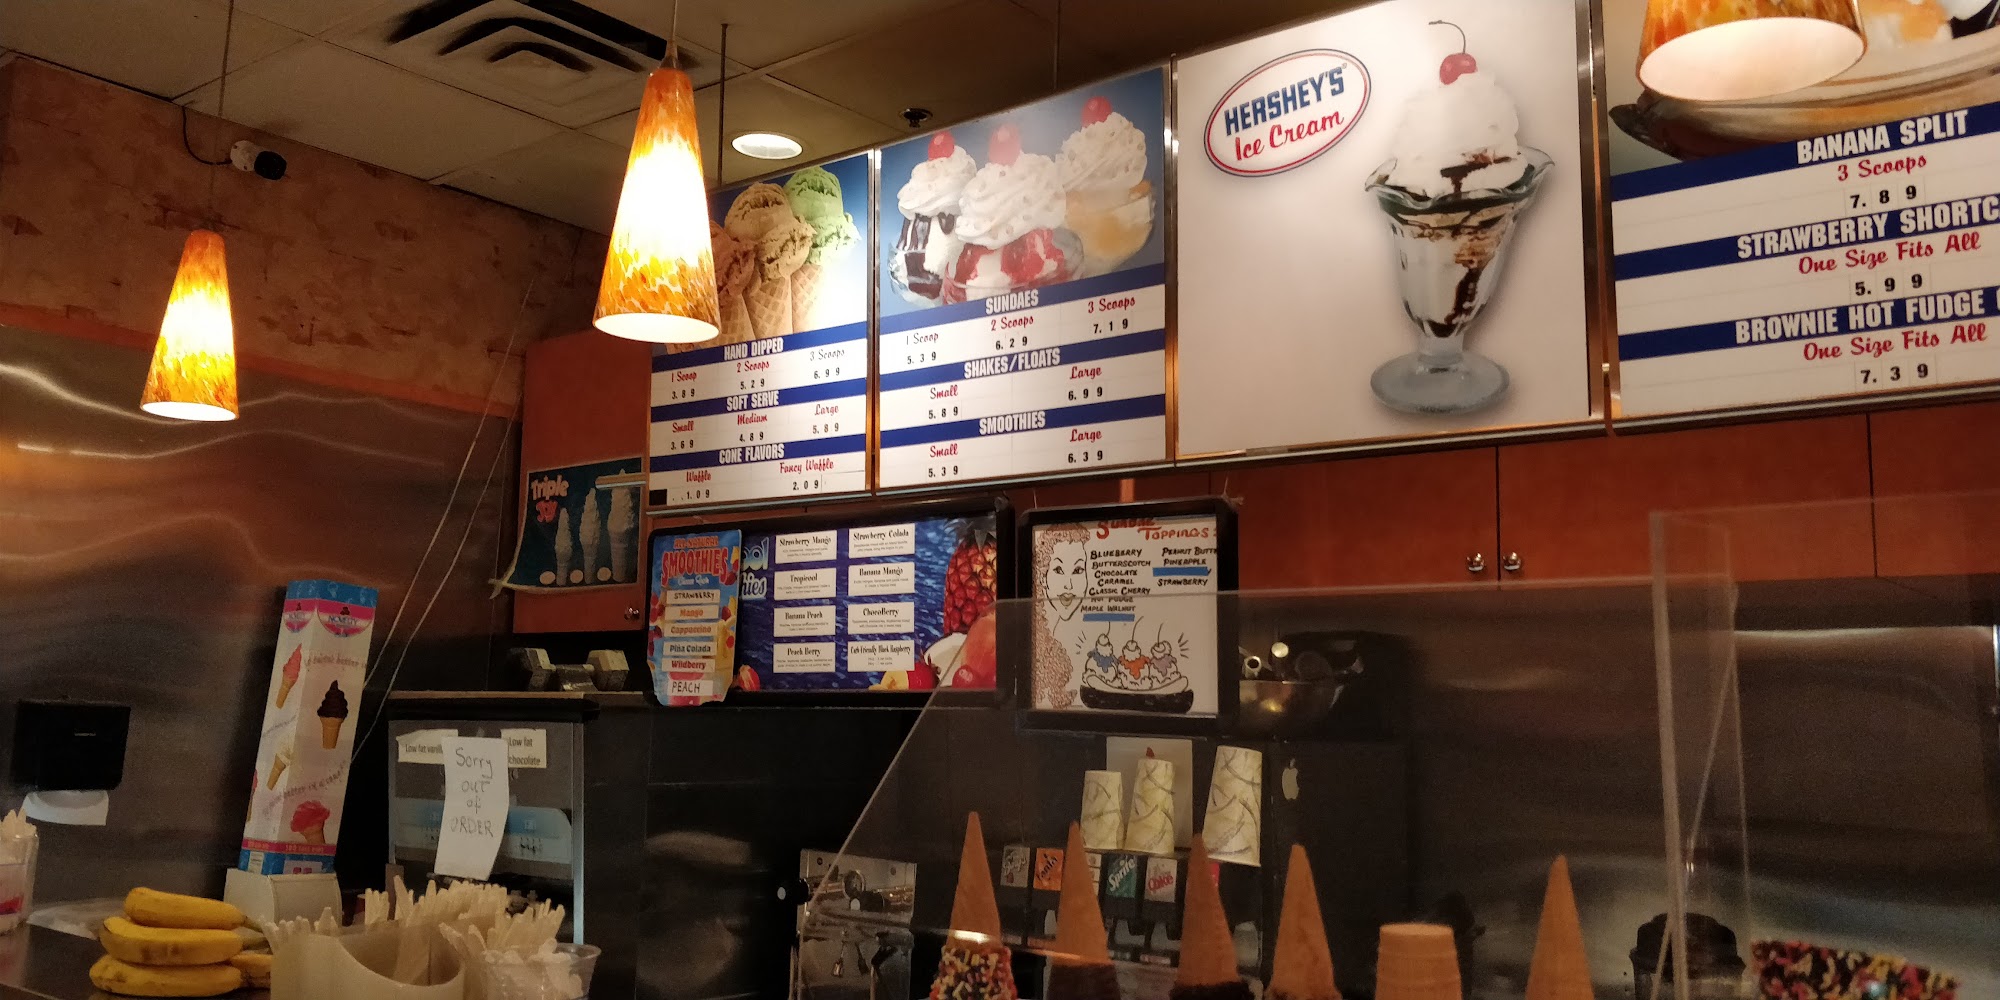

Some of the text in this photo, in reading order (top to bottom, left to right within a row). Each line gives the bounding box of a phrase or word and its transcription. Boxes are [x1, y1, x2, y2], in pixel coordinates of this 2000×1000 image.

[1224, 66, 1344, 136] HERSHEY'S
[1235, 111, 1345, 161] Ice Cream
[1797, 110, 1969, 165] BANANA SPLIT
[1838, 154, 1927, 181] 3 Scoops
[1737, 213, 1888, 259] STRAWBERRY
[1799, 231, 1981, 275] One Size Fits All
[986, 290, 1039, 315] SUNDAES
[1088, 296, 1136, 314] 3 Scoops
[1735, 309, 1838, 344] BROWNIE
[1848, 301, 1895, 330] HOT
[1905, 290, 1985, 324] FUDGE
[991, 316, 1034, 332] 2 Scoops
[914, 331, 939, 344] Scoop
[1803, 322, 1987, 361] One Size Fits All
[724, 337, 784, 361] HAND DIPPED
[809, 348, 845, 361] 3 Scoops
[736, 361, 770, 373] 2 Scoops
[1069, 366, 1102, 380] Large
[677, 371, 697, 383] Scoop
[930, 384, 959, 399] Small
[726, 390, 779, 412] SOFT SERVE
[814, 404, 839, 415] Large
[737, 414, 767, 425] Medium
[979, 410, 1046, 435] SMOOTHIES
[672, 421, 694, 433] Small
[1069, 429, 1102, 443] Large
[719, 443, 784, 464] CONE FLAVORS
[929, 443, 959, 458] Small
[780, 458, 834, 474] Fancy Waffle
[686, 471, 711, 483] Waffle
[530, 474, 569, 500] Triple
[780, 536, 832, 548] Strawberry Mango
[853, 532, 886, 541] Strawberry
[1090, 549, 1142, 560] BLUEBERRY
[1162, 547, 1192, 556] PEANUT
[661, 547, 728, 587] SMOOTHIES
[1091, 560, 1151, 569] BUTTERSCOTCH
[1163, 558, 1206, 566] PINEAPPLE
[859, 565, 904, 576] Banana Mango
[1094, 570, 1137, 578] CHOCOLATE
[1097, 578, 1134, 587] CARAMEL
[1157, 579, 1208, 587] STRAWBERRY
[674, 591, 715, 600] STRAWBERRY
[1089, 587, 1151, 596] CLASSIC CHERRY
[680, 608, 704, 617] Mango
[785, 611, 823, 620] Banana Peach
[1081, 605, 1103, 613] MAPLE
[671, 625, 711, 636] Cappuccino
[686, 645, 711, 653] Colada
[787, 647, 821, 657] Peach Berry
[671, 660, 706, 670] Wildberry
[671, 681, 701, 694] PEACH
[405, 744, 418, 753] Low
[419, 744, 427, 753] fat
[509, 737, 533, 748] Low fat
[455, 747, 493, 779] Sorry
[466, 795, 481, 815] of
[450, 816, 494, 838] ORDER
[1108, 855, 1136, 892] Sprite
